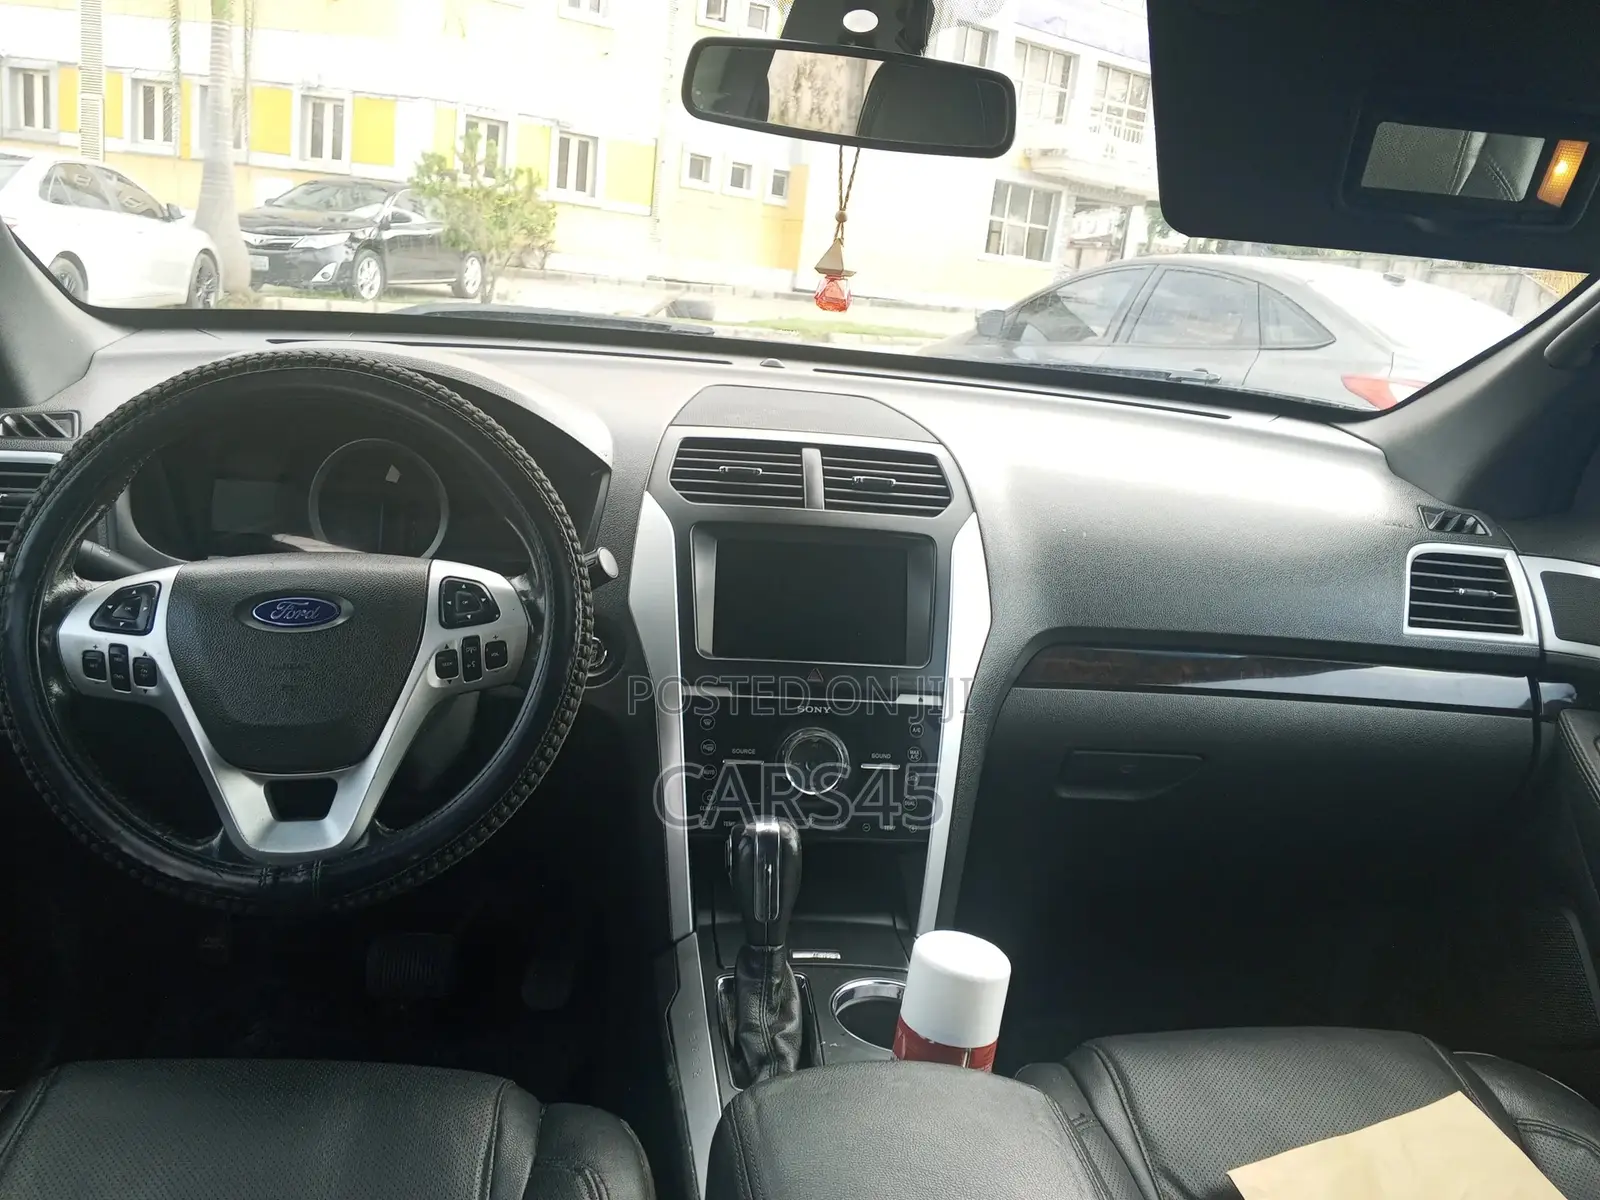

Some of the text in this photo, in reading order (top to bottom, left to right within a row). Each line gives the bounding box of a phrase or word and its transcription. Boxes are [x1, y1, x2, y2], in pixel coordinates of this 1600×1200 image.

[270, 601, 321, 620] Ford
[797, 705, 832, 714] SONY
[871, 752, 892, 760] SOUND
